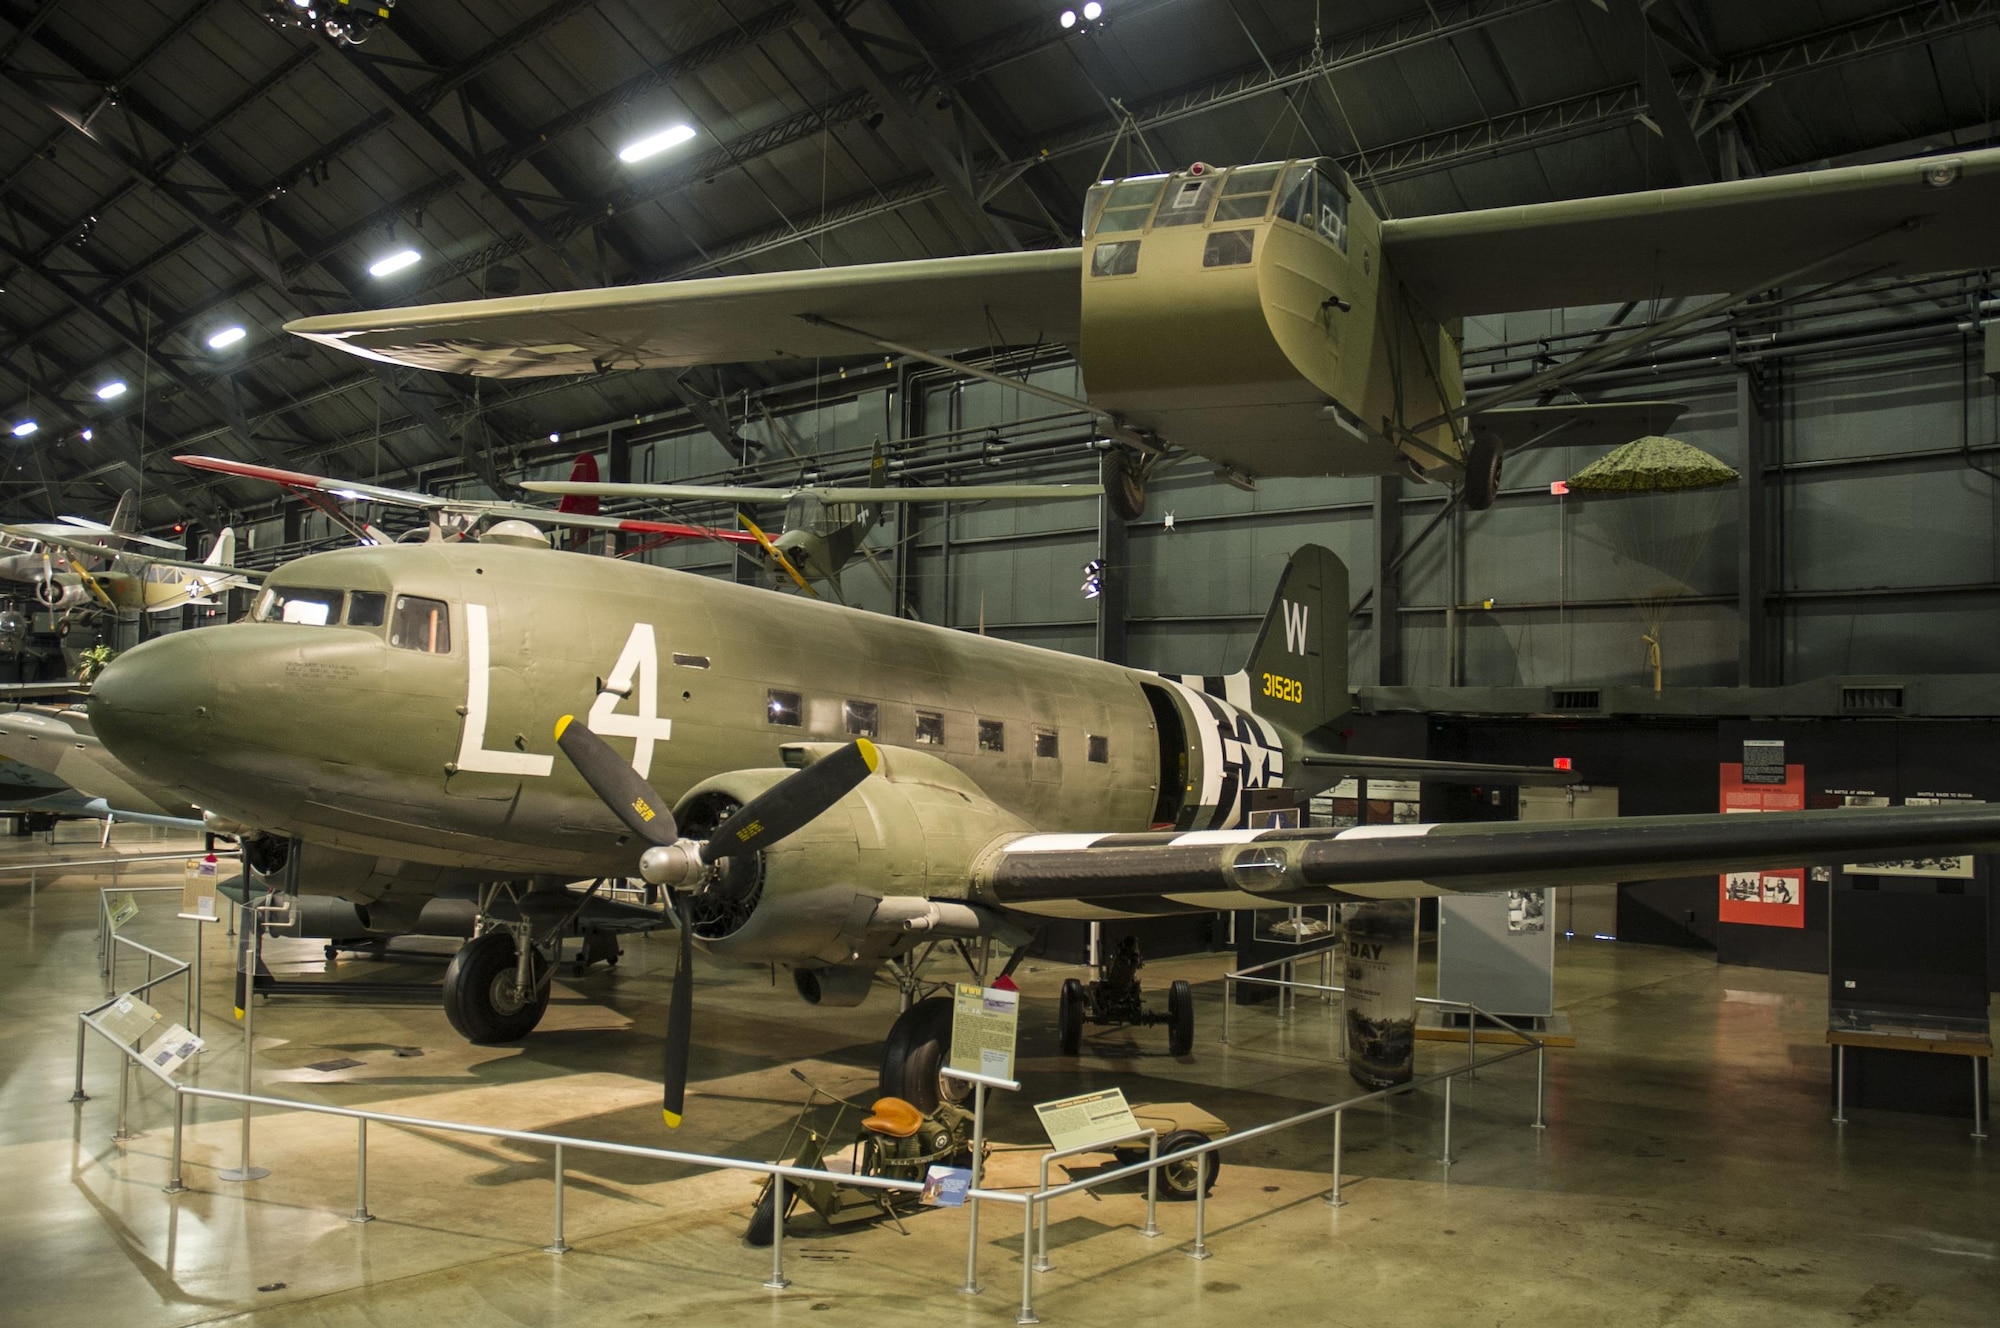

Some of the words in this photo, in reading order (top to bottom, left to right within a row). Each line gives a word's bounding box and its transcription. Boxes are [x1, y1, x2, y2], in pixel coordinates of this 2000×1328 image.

[1282, 599, 1308, 656] W
[456, 604, 554, 776] L
[588, 623, 672, 779] 4
[1262, 672, 1303, 704] 315213
